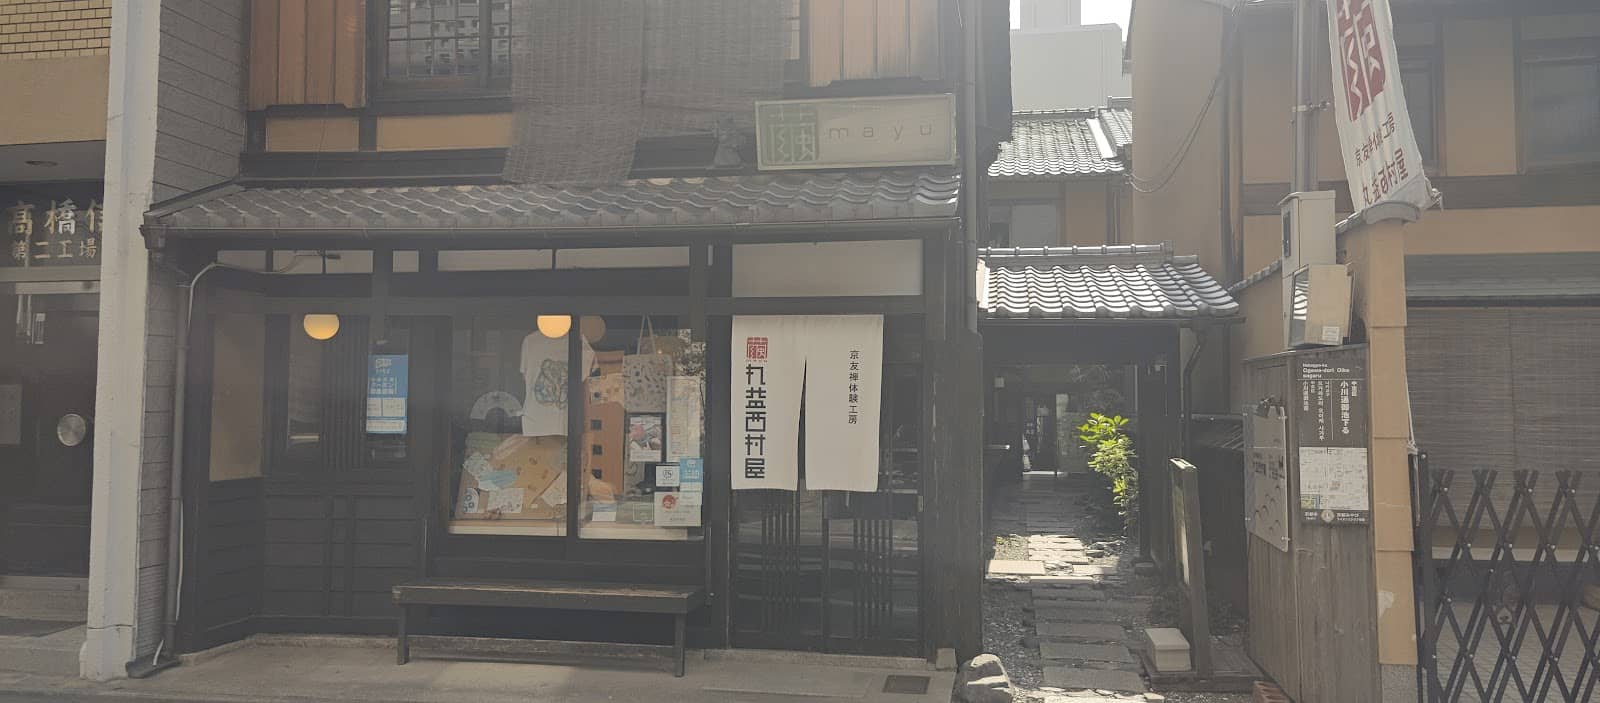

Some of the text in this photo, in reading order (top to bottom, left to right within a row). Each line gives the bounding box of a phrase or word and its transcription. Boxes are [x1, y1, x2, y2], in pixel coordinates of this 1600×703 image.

[828, 122, 933, 141] mayu
[848, 350, 860, 425] 京友禅体験工房
